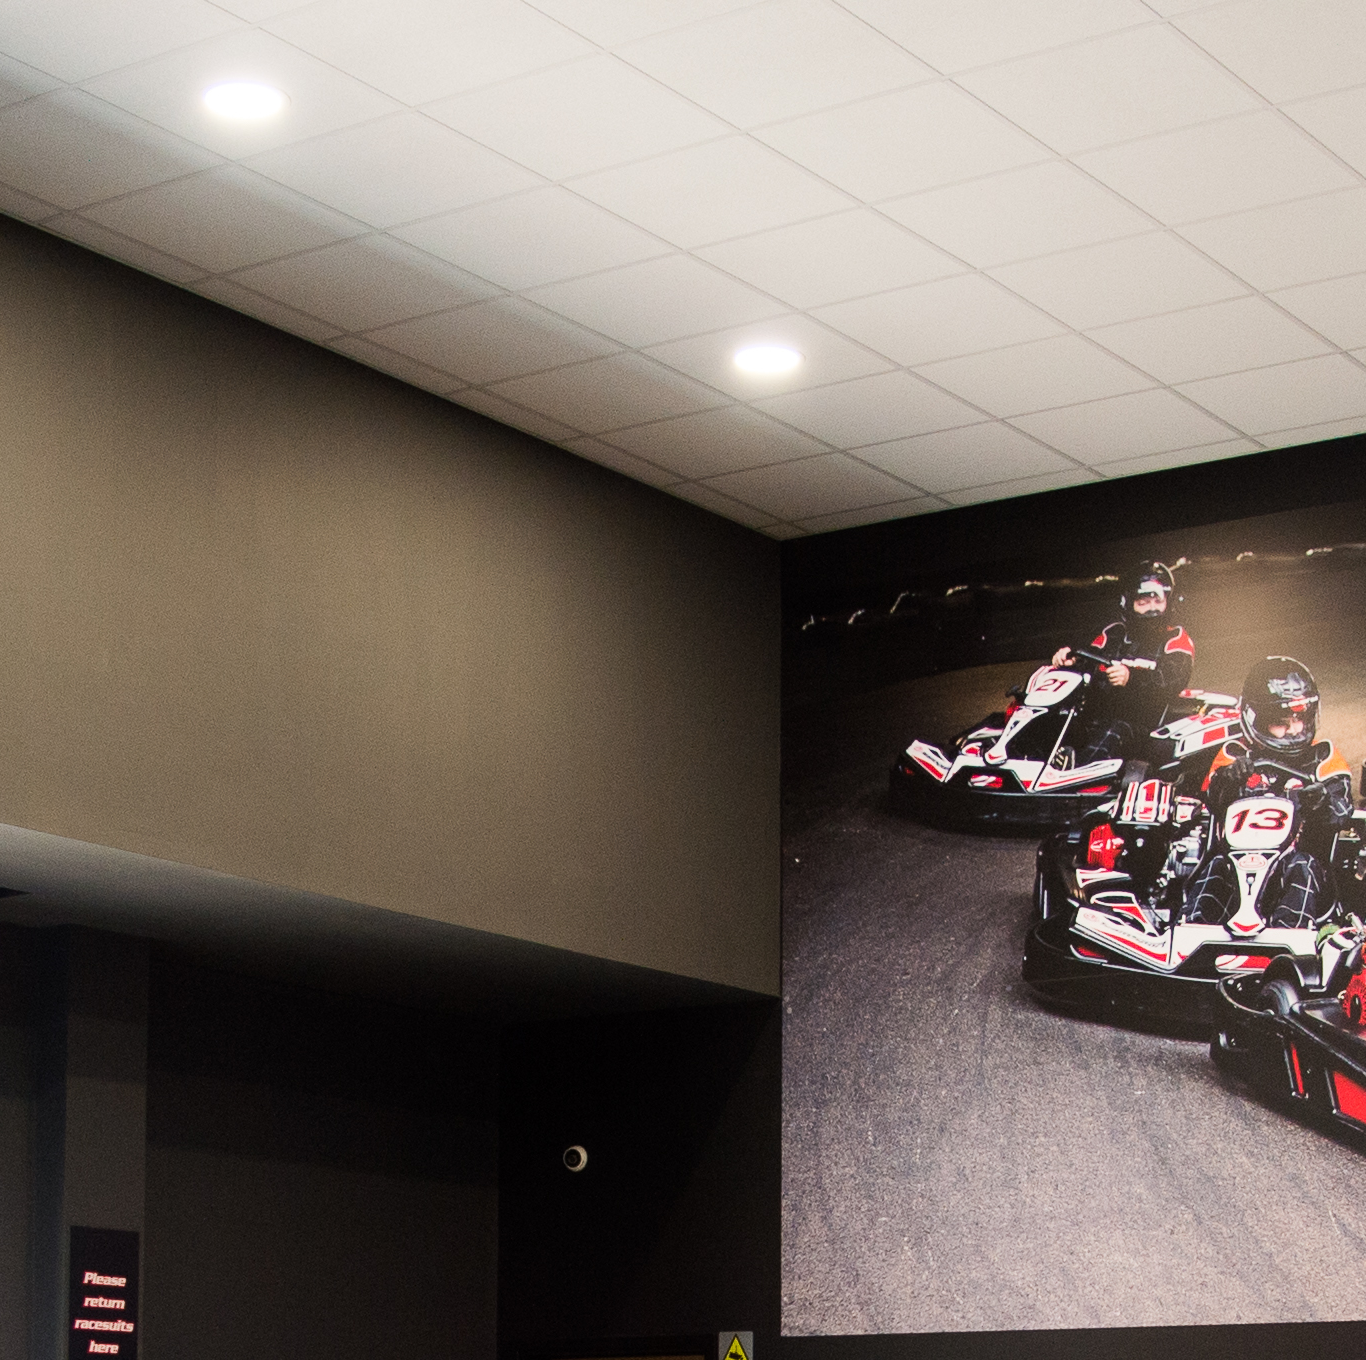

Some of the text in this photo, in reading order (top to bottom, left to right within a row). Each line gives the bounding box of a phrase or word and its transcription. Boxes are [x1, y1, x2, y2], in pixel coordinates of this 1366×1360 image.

[1034, 677, 1072, 694] 21
[1231, 806, 1289, 835] 13
[83, 1271, 127, 1287] Please
[83, 1296, 126, 1309] return
[74, 1318, 135, 1332] racesuits
[88, 1340, 120, 1354] here
